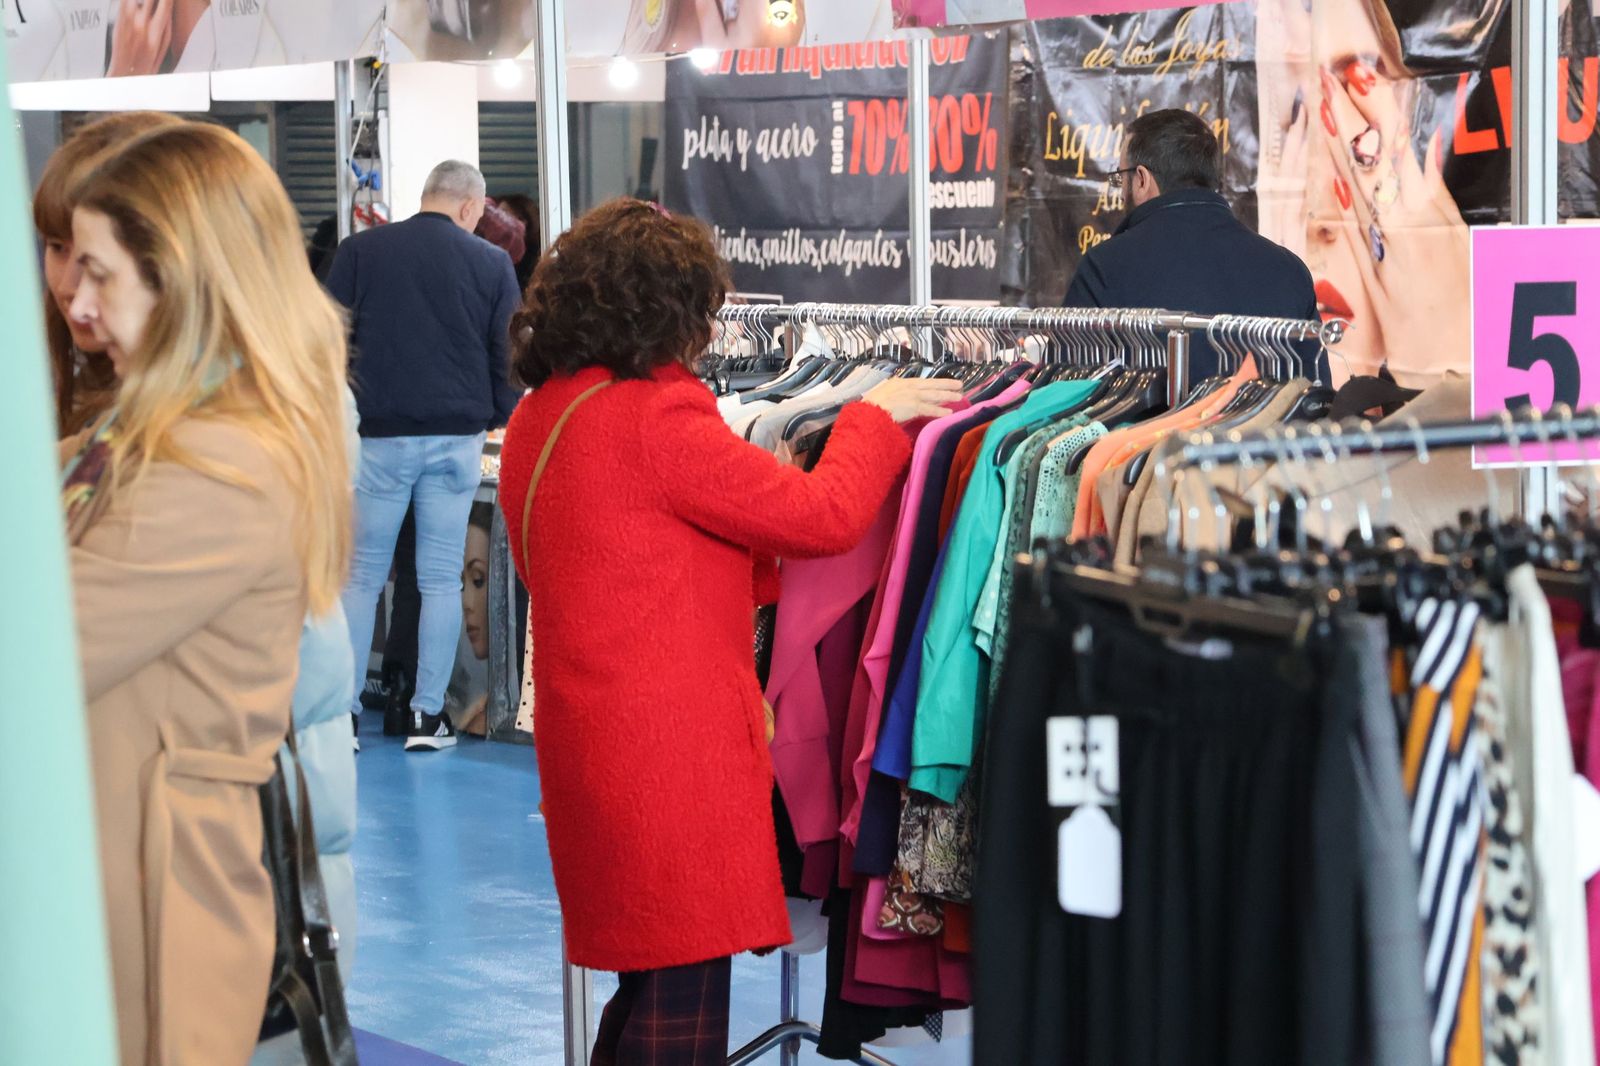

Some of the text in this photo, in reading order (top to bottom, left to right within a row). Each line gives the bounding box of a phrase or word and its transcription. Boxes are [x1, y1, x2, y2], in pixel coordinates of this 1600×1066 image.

[702, 47, 777, 75] ran
[1083, 24, 1117, 69] de
[1122, 21, 1157, 67] las
[681, 114, 819, 172] plata y acero
[830, 100, 845, 174] todo al
[847, 97, 910, 177] 70%
[1503, 281, 1581, 424] 5
